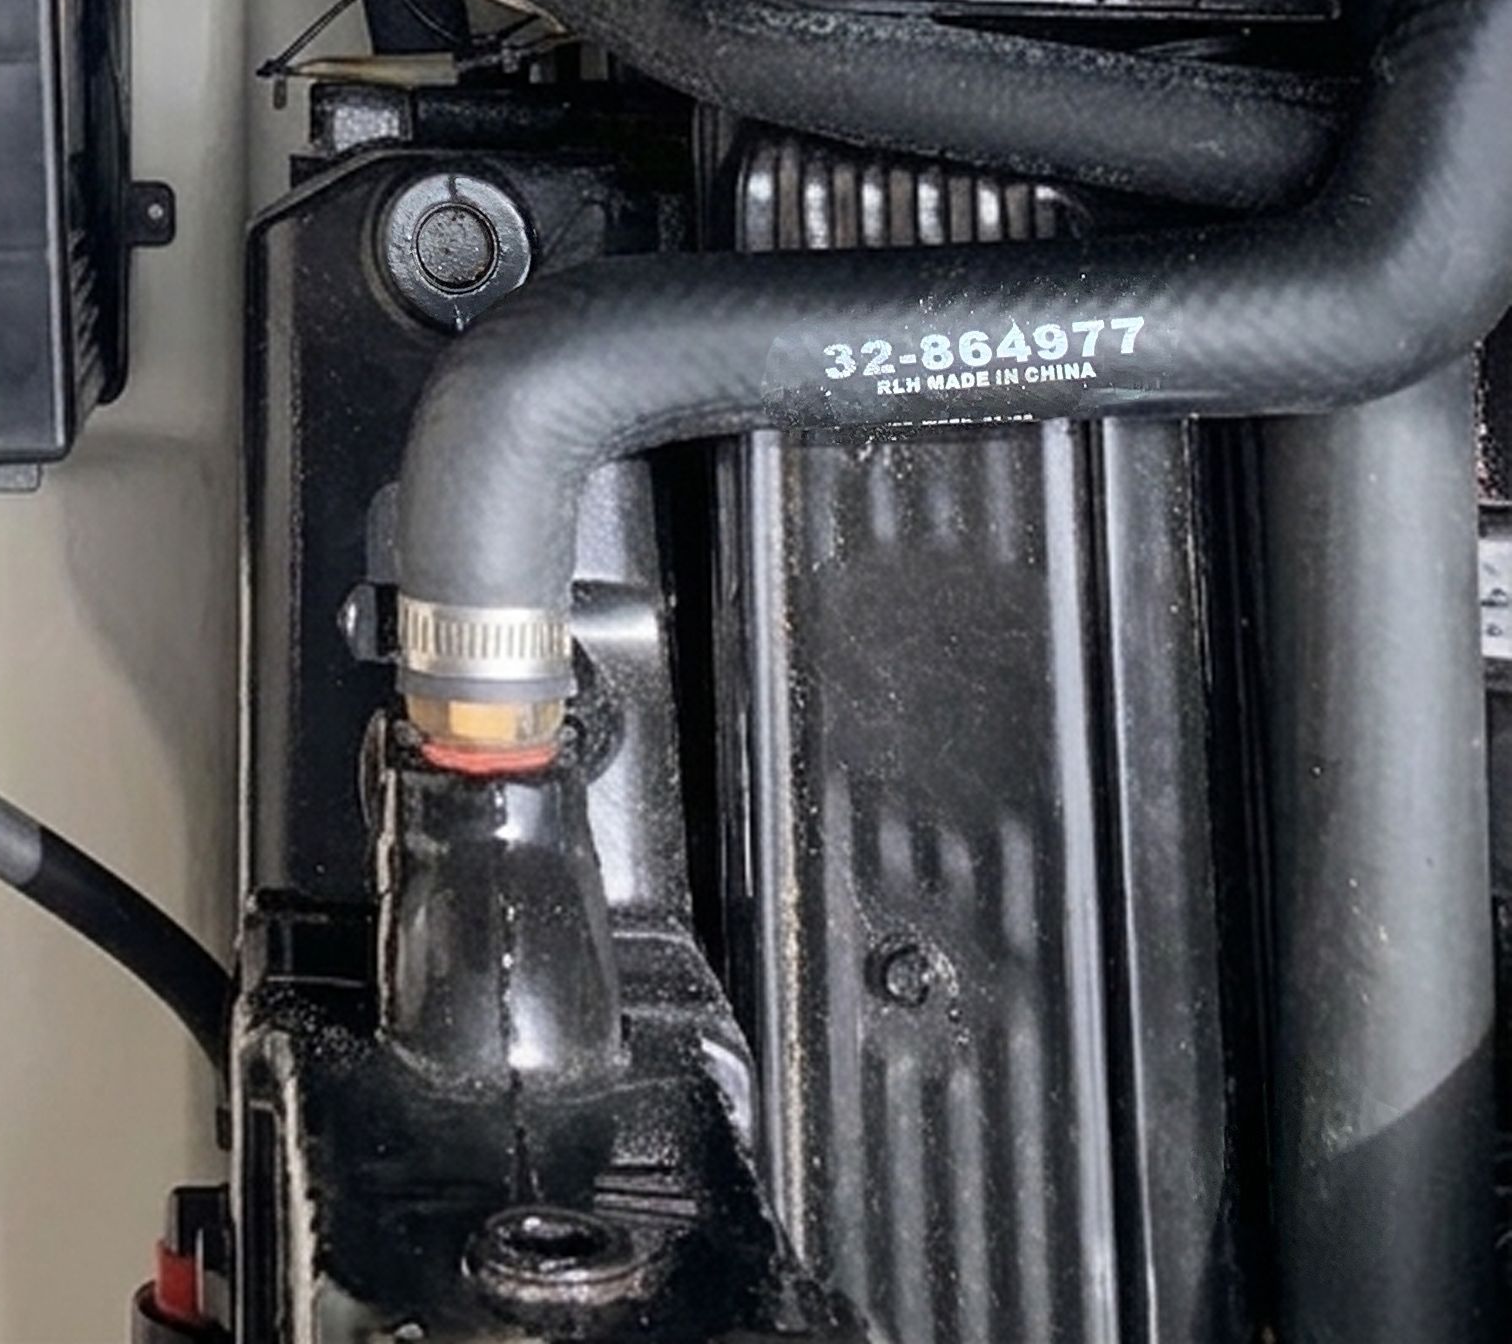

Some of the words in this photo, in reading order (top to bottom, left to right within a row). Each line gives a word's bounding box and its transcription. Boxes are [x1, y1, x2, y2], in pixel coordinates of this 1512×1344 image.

[823, 317, 1144, 379] 32-864977
[878, 381, 920, 395] RLH
[928, 372, 990, 391] MADE
[996, 369, 1018, 385] IN
[1026, 363, 1096, 382] CHINA
